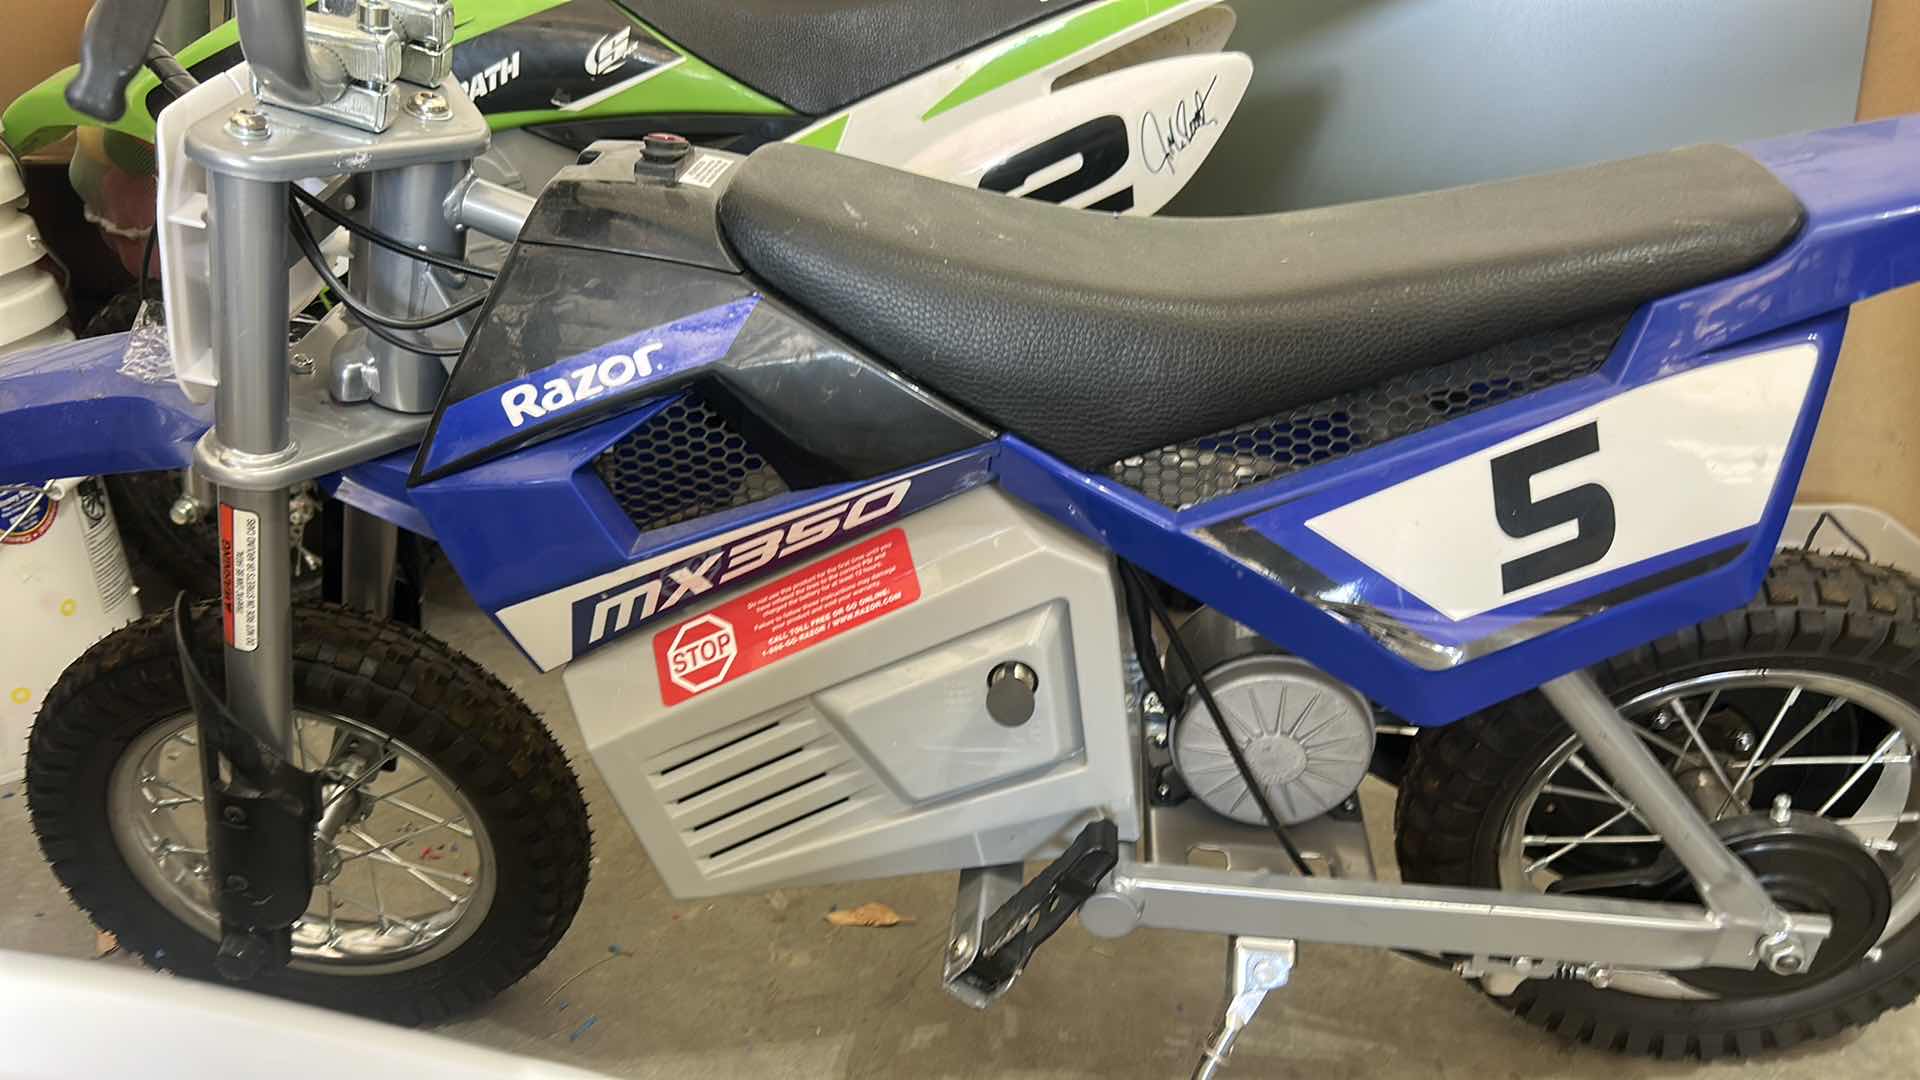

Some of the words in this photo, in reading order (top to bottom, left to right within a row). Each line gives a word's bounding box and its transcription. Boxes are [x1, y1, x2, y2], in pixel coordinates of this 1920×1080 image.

[500, 341, 664, 428] Razor
[1490, 420, 1616, 595] 5
[672, 632, 731, 674] STOP
